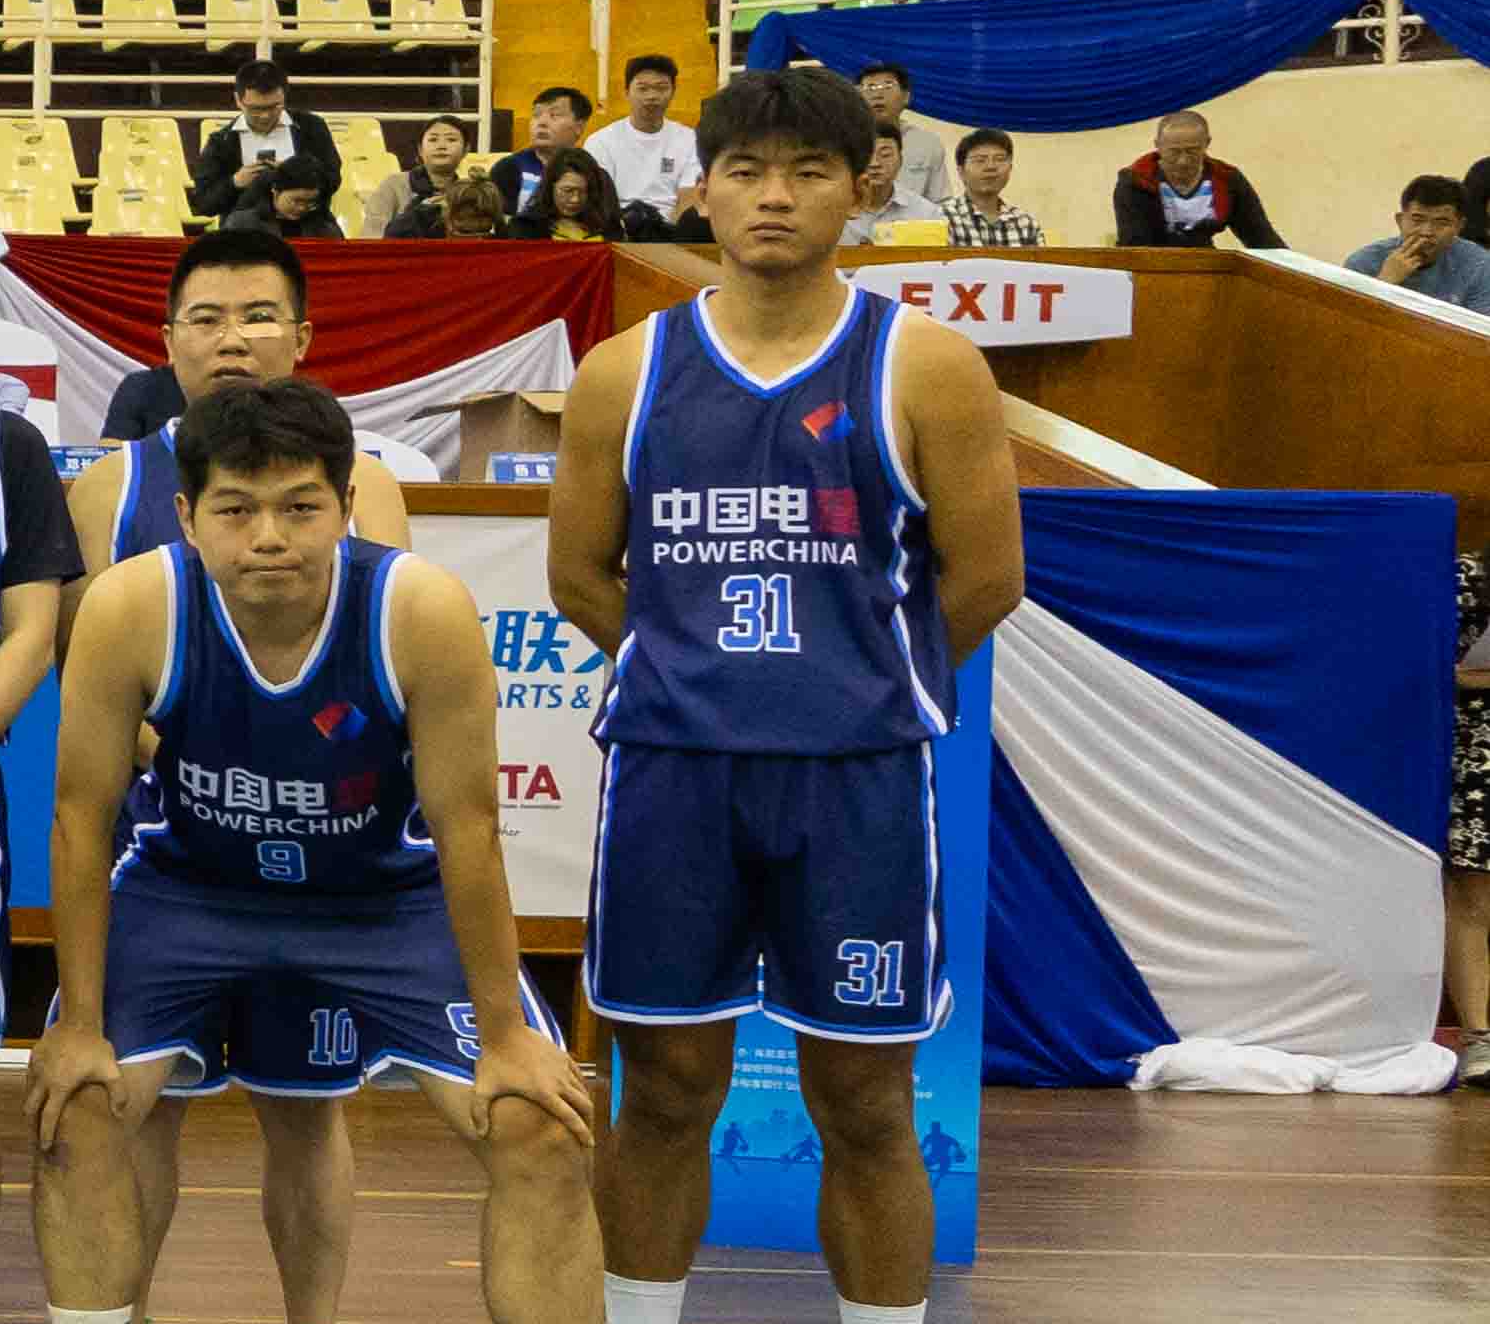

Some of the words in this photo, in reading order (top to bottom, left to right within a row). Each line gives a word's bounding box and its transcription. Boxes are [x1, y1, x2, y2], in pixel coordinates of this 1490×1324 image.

[653, 539, 858, 565] POWERCHINA
[717, 572, 801, 652] 31
[497, 683, 563, 709] RTS
[570, 684, 591, 709] &
[180, 792, 379, 835] POWERCHINA
[257, 840, 307, 883] 9
[835, 939, 906, 1006] 31
[307, 1008, 357, 1066] 10
